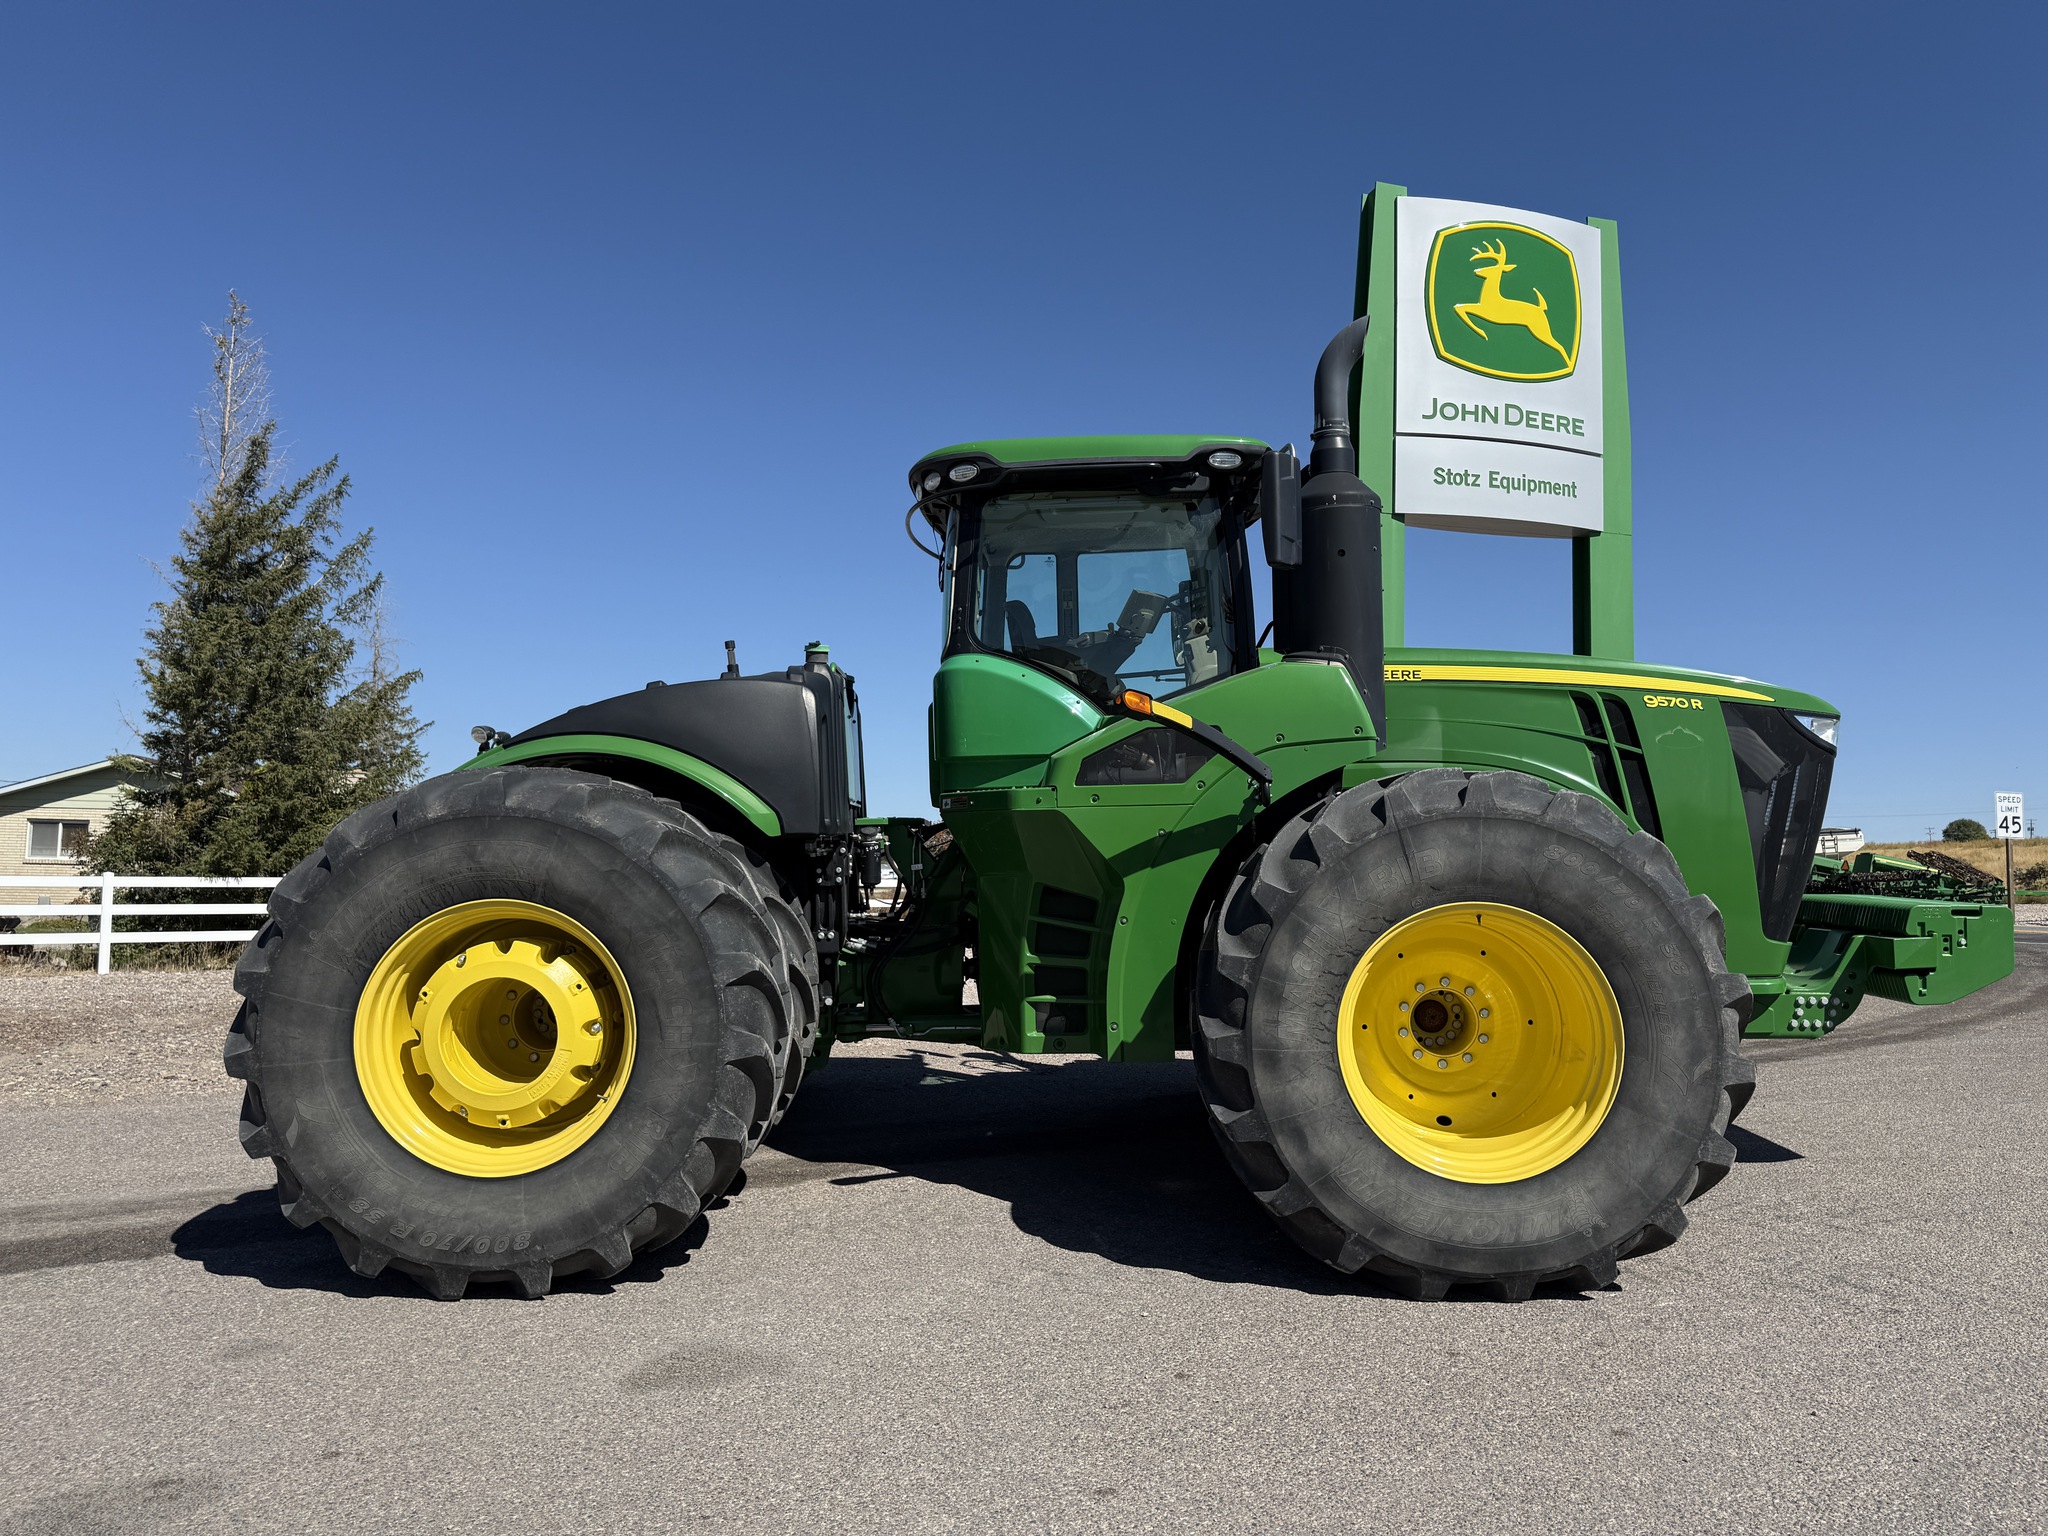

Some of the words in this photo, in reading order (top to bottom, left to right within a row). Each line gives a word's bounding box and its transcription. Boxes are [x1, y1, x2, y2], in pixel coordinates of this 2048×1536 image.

[1422, 398, 1498, 424] JOHN
[1504, 403, 1584, 437] DEERE
[1433, 467, 1480, 487] Stotz
[1489, 470, 1577, 498] Equipment
[1643, 694, 1689, 709] 9570
[1690, 698, 1704, 710] R
[1998, 795, 2021, 803] SPEED
[2000, 805, 2018, 813] LIMIT
[1998, 815, 2022, 834] 45
[1543, 844, 1646, 910] 800/70
[1641, 915, 1667, 937] R
[1659, 943, 1691, 977] 38
[1277, 923, 1338, 1042] MACH
[1368, 848, 1443, 898] BIB
[639, 931, 694, 1050] MACH
[1588, 902, 1643, 955] RADIAL
[1638, 959, 1673, 1048] TUBELESS
[607, 1106, 672, 1182] BIB
[330, 1132, 401, 1197] TUBELESS
[349, 1197, 389, 1226] 38
[1337, 1167, 1562, 1245] MICHELIN
[390, 1218, 416, 1240] R
[418, 1230, 533, 1255] 800/70
